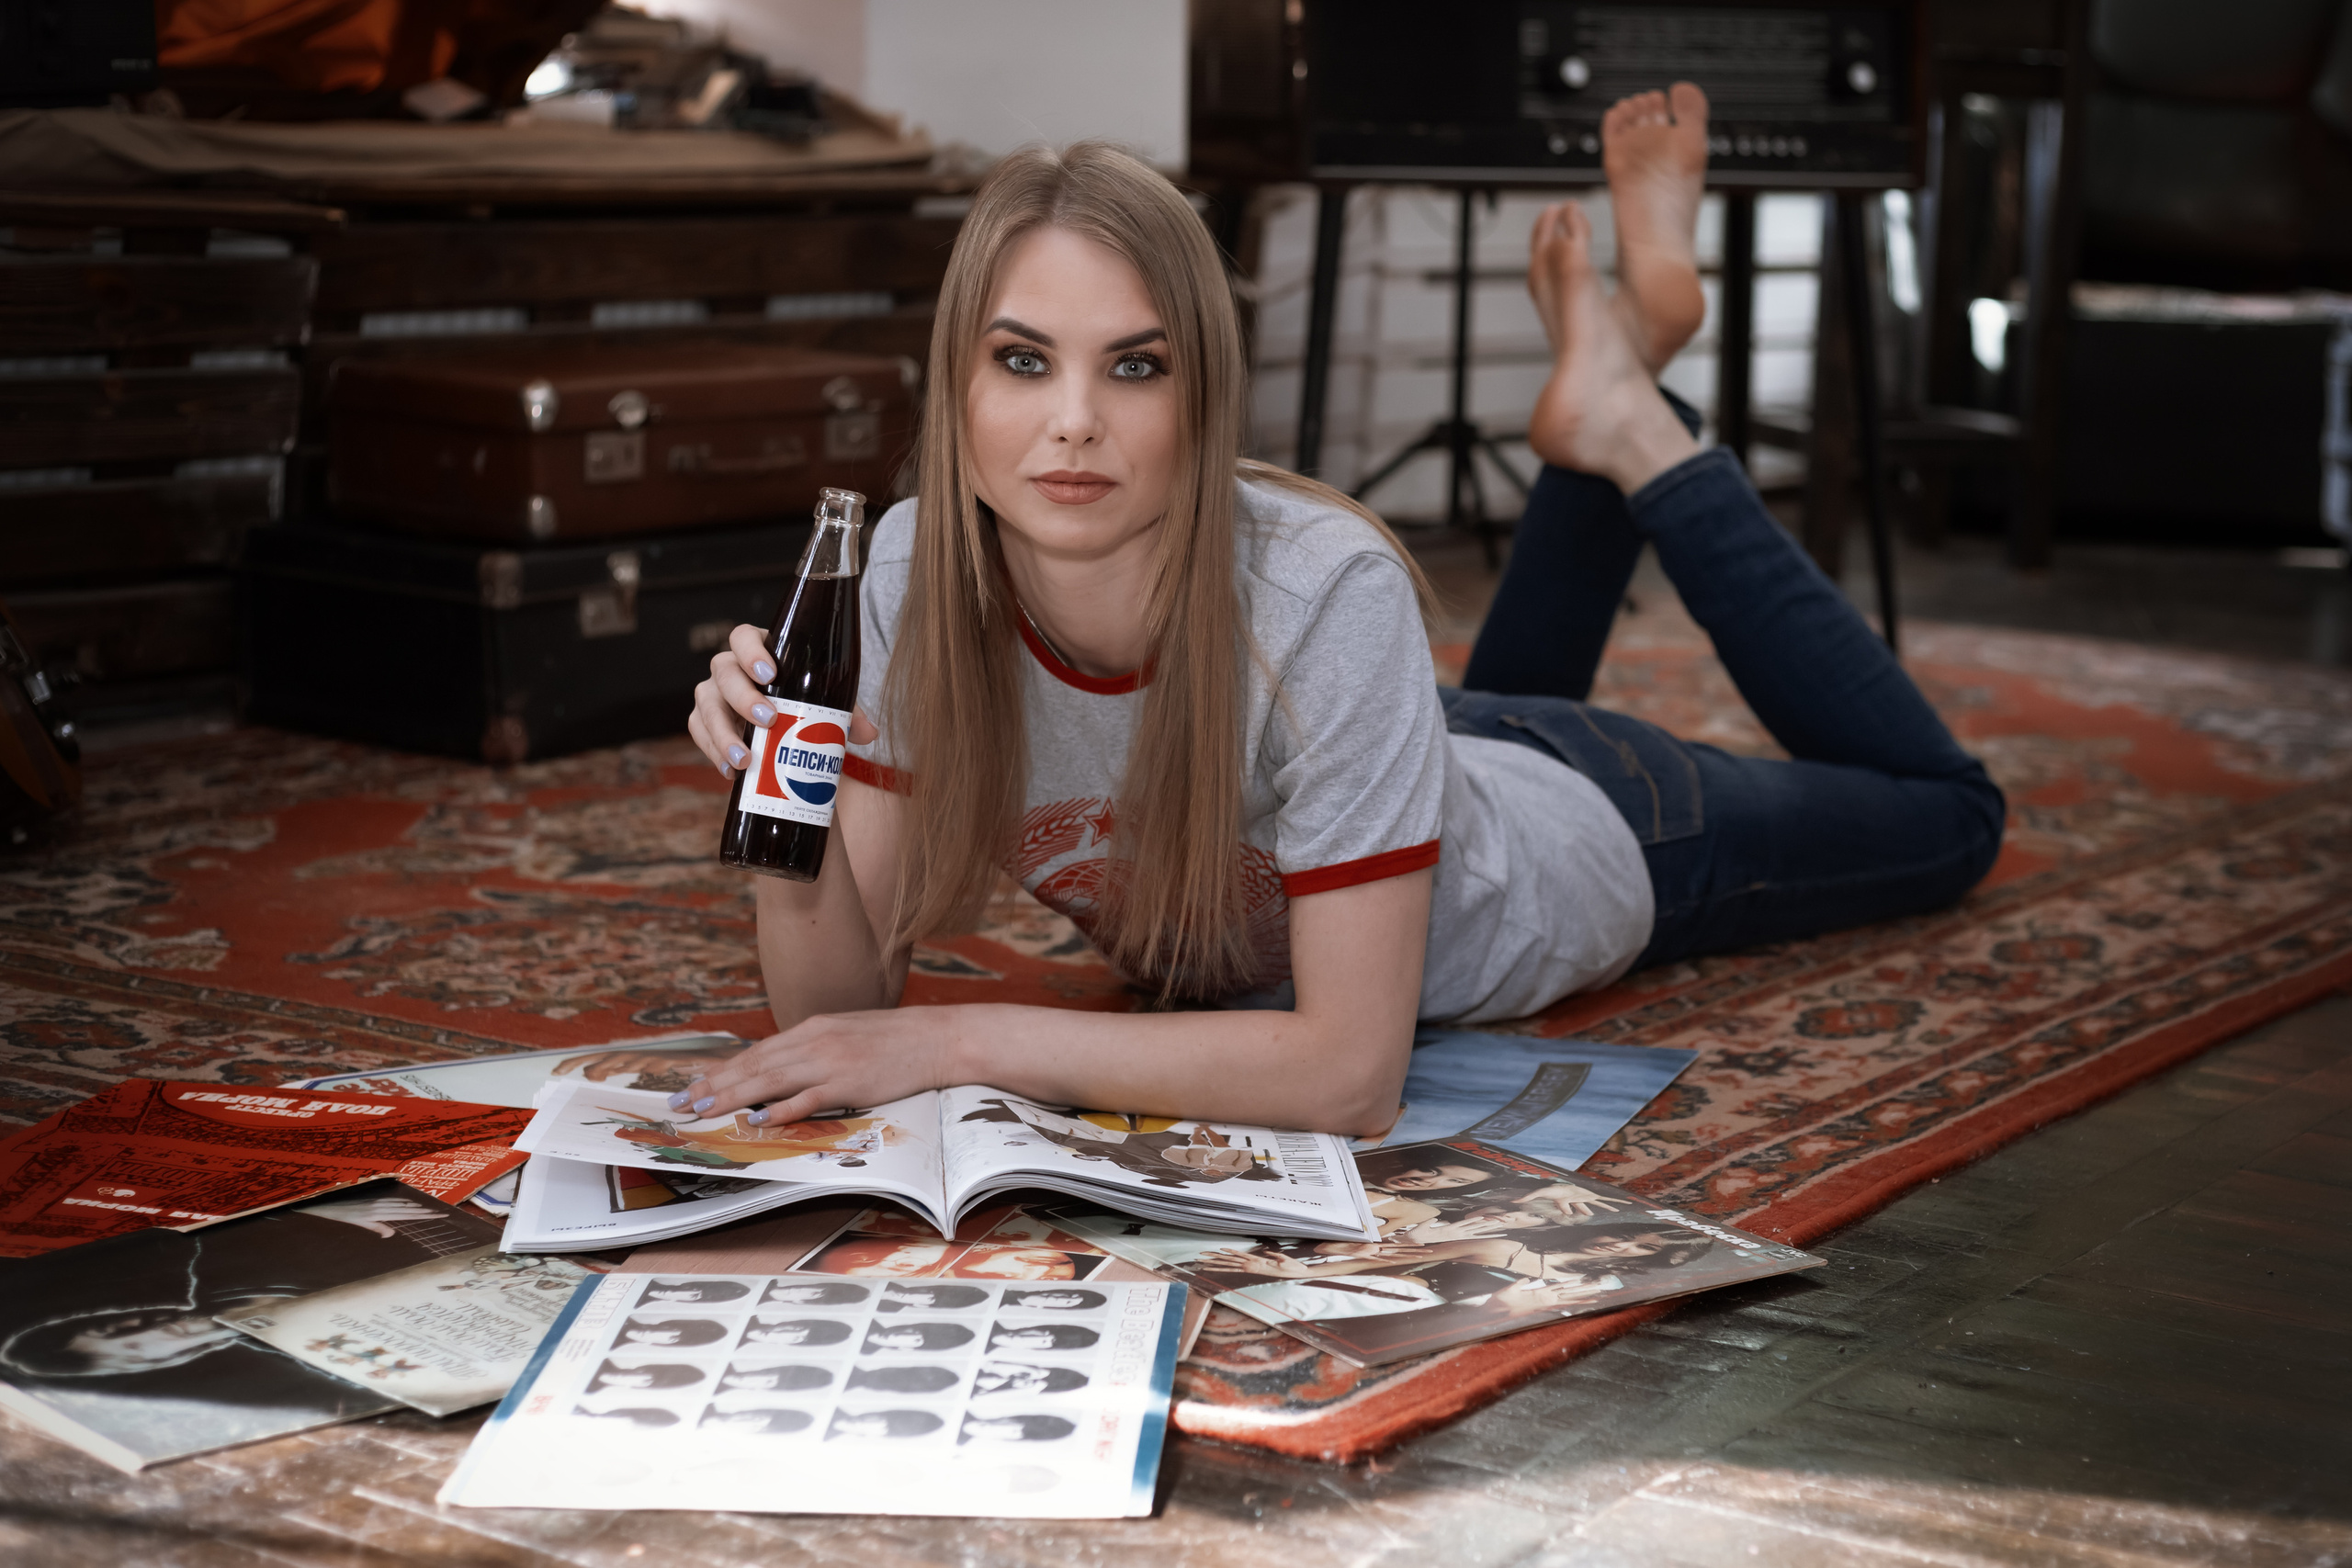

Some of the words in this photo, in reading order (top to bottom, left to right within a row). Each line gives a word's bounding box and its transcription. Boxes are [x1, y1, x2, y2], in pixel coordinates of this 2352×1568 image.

[177, 1092, 299, 1109] МОРИА
[299, 1100, 397, 1116] ПОЛЯ
[224, 1104, 316, 1118] ОРКЕСТР
[62, 1197, 163, 1214] МОРИА
[1255, 1194, 1322, 1207] ЖАКЕТЫ
[551, 1223, 617, 1232] ВЫРЕЗЫ
[1645, 1209, 1762, 1249] Арабеска
[574, 1278, 637, 1329] БИТЛЗ
[1124, 1286, 1162, 1315] The
[1109, 1319, 1155, 1383] Beatles
